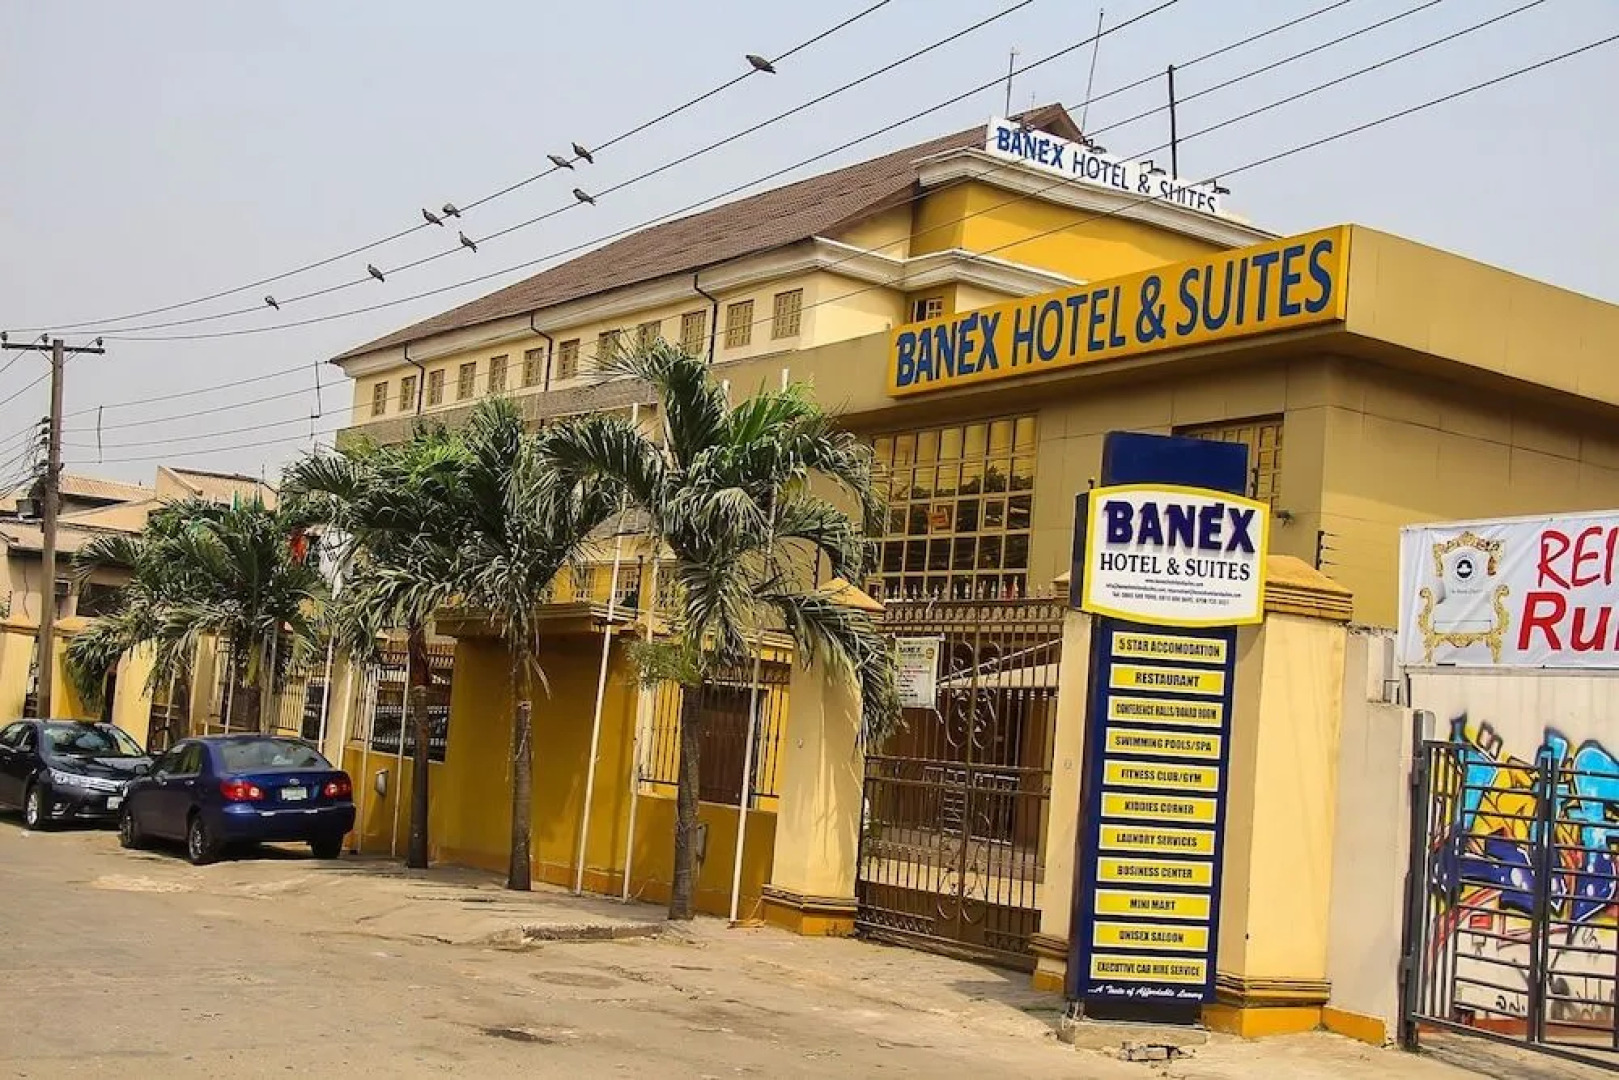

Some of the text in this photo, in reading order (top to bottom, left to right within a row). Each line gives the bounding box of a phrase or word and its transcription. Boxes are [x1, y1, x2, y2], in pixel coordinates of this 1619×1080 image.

[1073, 151, 1129, 190] HOTEL
[1138, 173, 1150, 194] &
[1011, 286, 1126, 367] HOTEL
[1135, 275, 1166, 344] &
[1175, 239, 1334, 336] SUITES
[1100, 553, 1250, 581] HOTEL & SUITES
[1517, 591, 1619, 651] Ru
[1119, 638, 1219, 657] 5 STAR ACCOMODATION
[1135, 672, 1200, 687] RESTAURANT
[1115, 736, 1211, 751] SWIMMING POOLS/SPA
[1121, 768, 1202, 783] FITNESS CLUB/GYM
[1124, 800, 1194, 814] KIDDIES CORNER
[1117, 833, 1197, 848] LAUNDRY SERVICES
[1117, 865, 1193, 878] BUSINESS CENTER
[1130, 898, 1176, 911] MINI MART
[1119, 930, 1184, 943] UNISEX SALOON
[1097, 961, 1199, 976] EXECUTIVE CAR HIRE SERVICE
[1127, 987, 1136, 998] of
